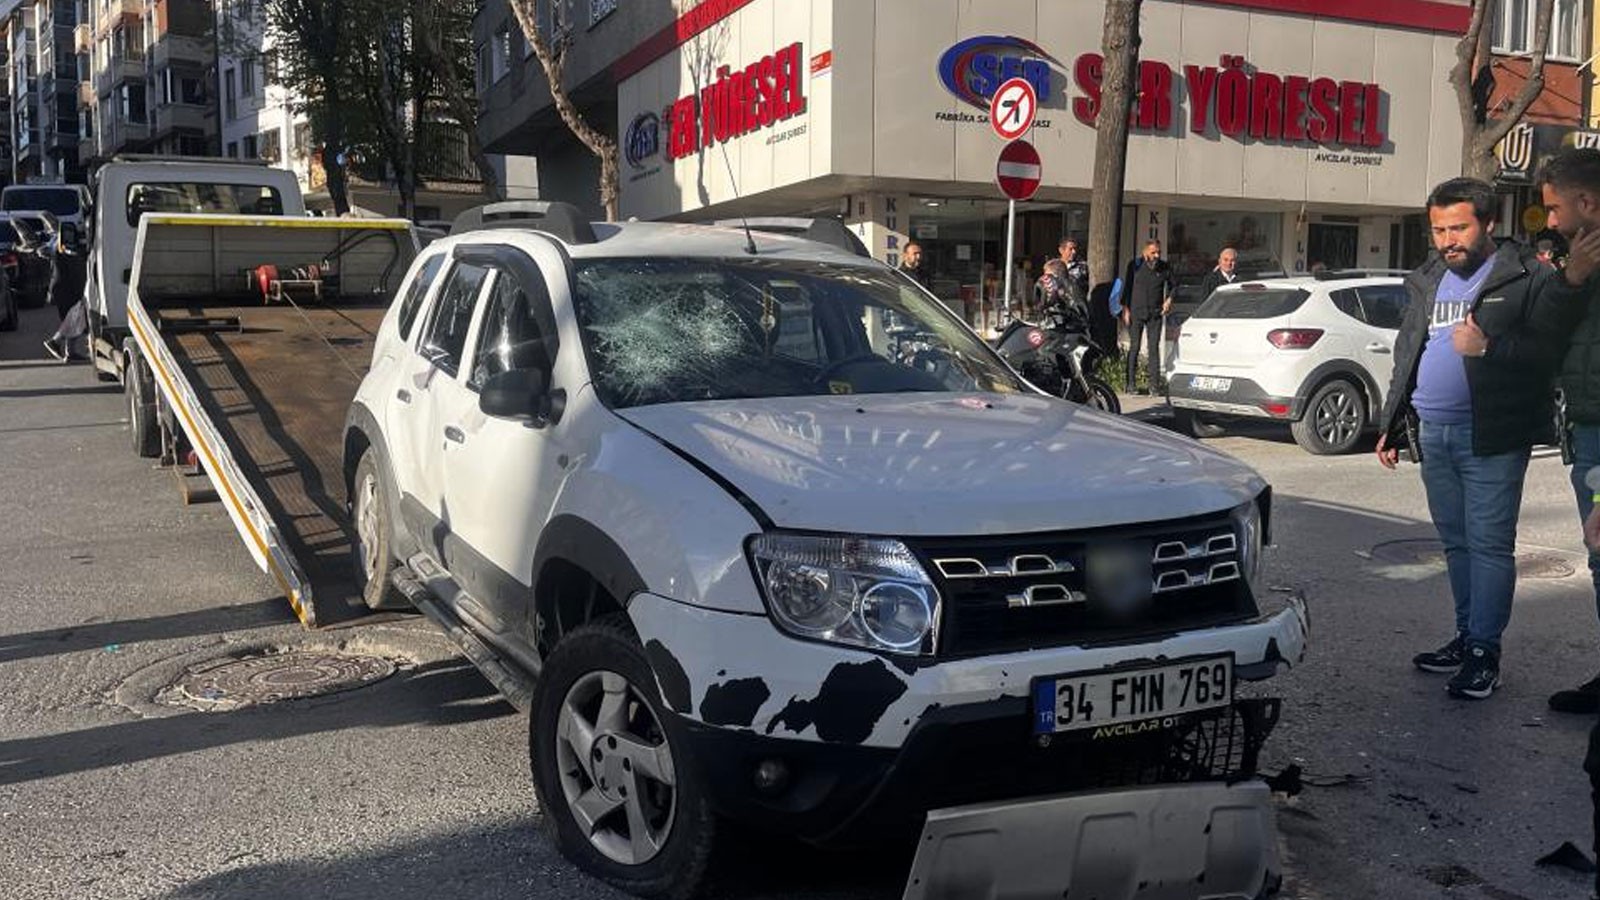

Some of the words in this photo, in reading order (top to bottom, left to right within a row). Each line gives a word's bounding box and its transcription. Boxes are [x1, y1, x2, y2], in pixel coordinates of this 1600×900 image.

[701, 42, 807, 148] YÖRESEL
[1072, 53, 1172, 130] SR
[1184, 54, 1384, 147] YÖRESEL
[1040, 710, 1054, 723] TR
[1057, 682, 1094, 725] 34
[1111, 673, 1165, 718] FMN
[1178, 664, 1226, 708] 769
[1092, 719, 1160, 740] AVCILAR
